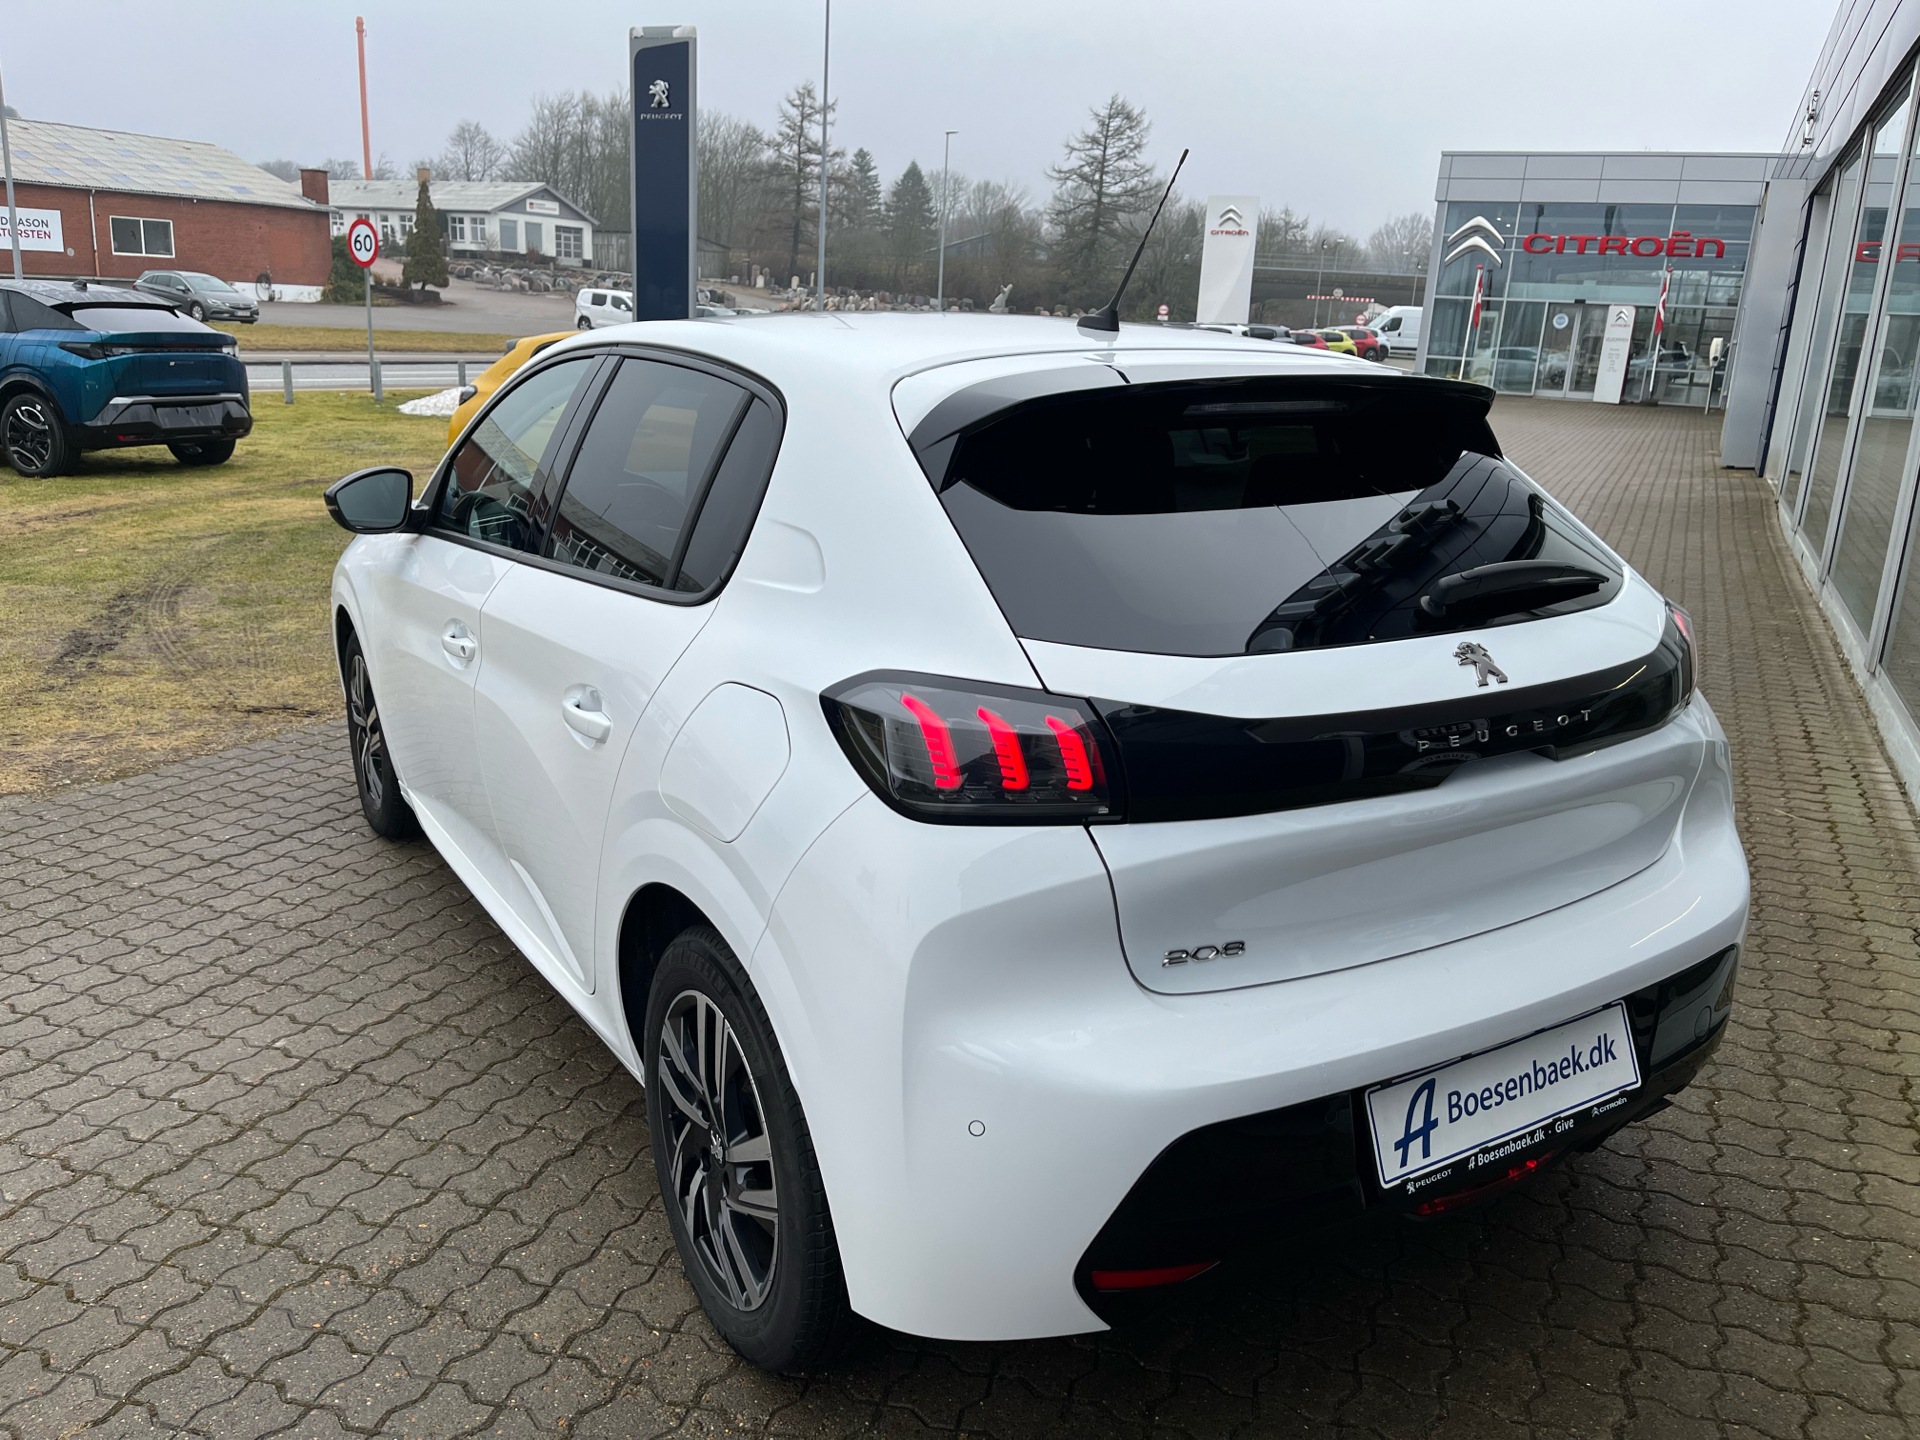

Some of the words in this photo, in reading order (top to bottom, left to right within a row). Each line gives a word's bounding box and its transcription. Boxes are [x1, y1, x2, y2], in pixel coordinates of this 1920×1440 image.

[0, 216, 49, 228] DASON
[354, 234, 373, 252] 60
[1523, 231, 1725, 258] CITROËN
[1417, 709, 1592, 753] PEUGEOT
[1162, 940, 1246, 968] 208
[1447, 1033, 1617, 1124] Boesenbaek.dk
[1477, 1128, 1545, 1166] Boesenbaek.dk
[1555, 1118, 1574, 1133] Give
[1415, 1168, 1452, 1189] PEUGEOT
